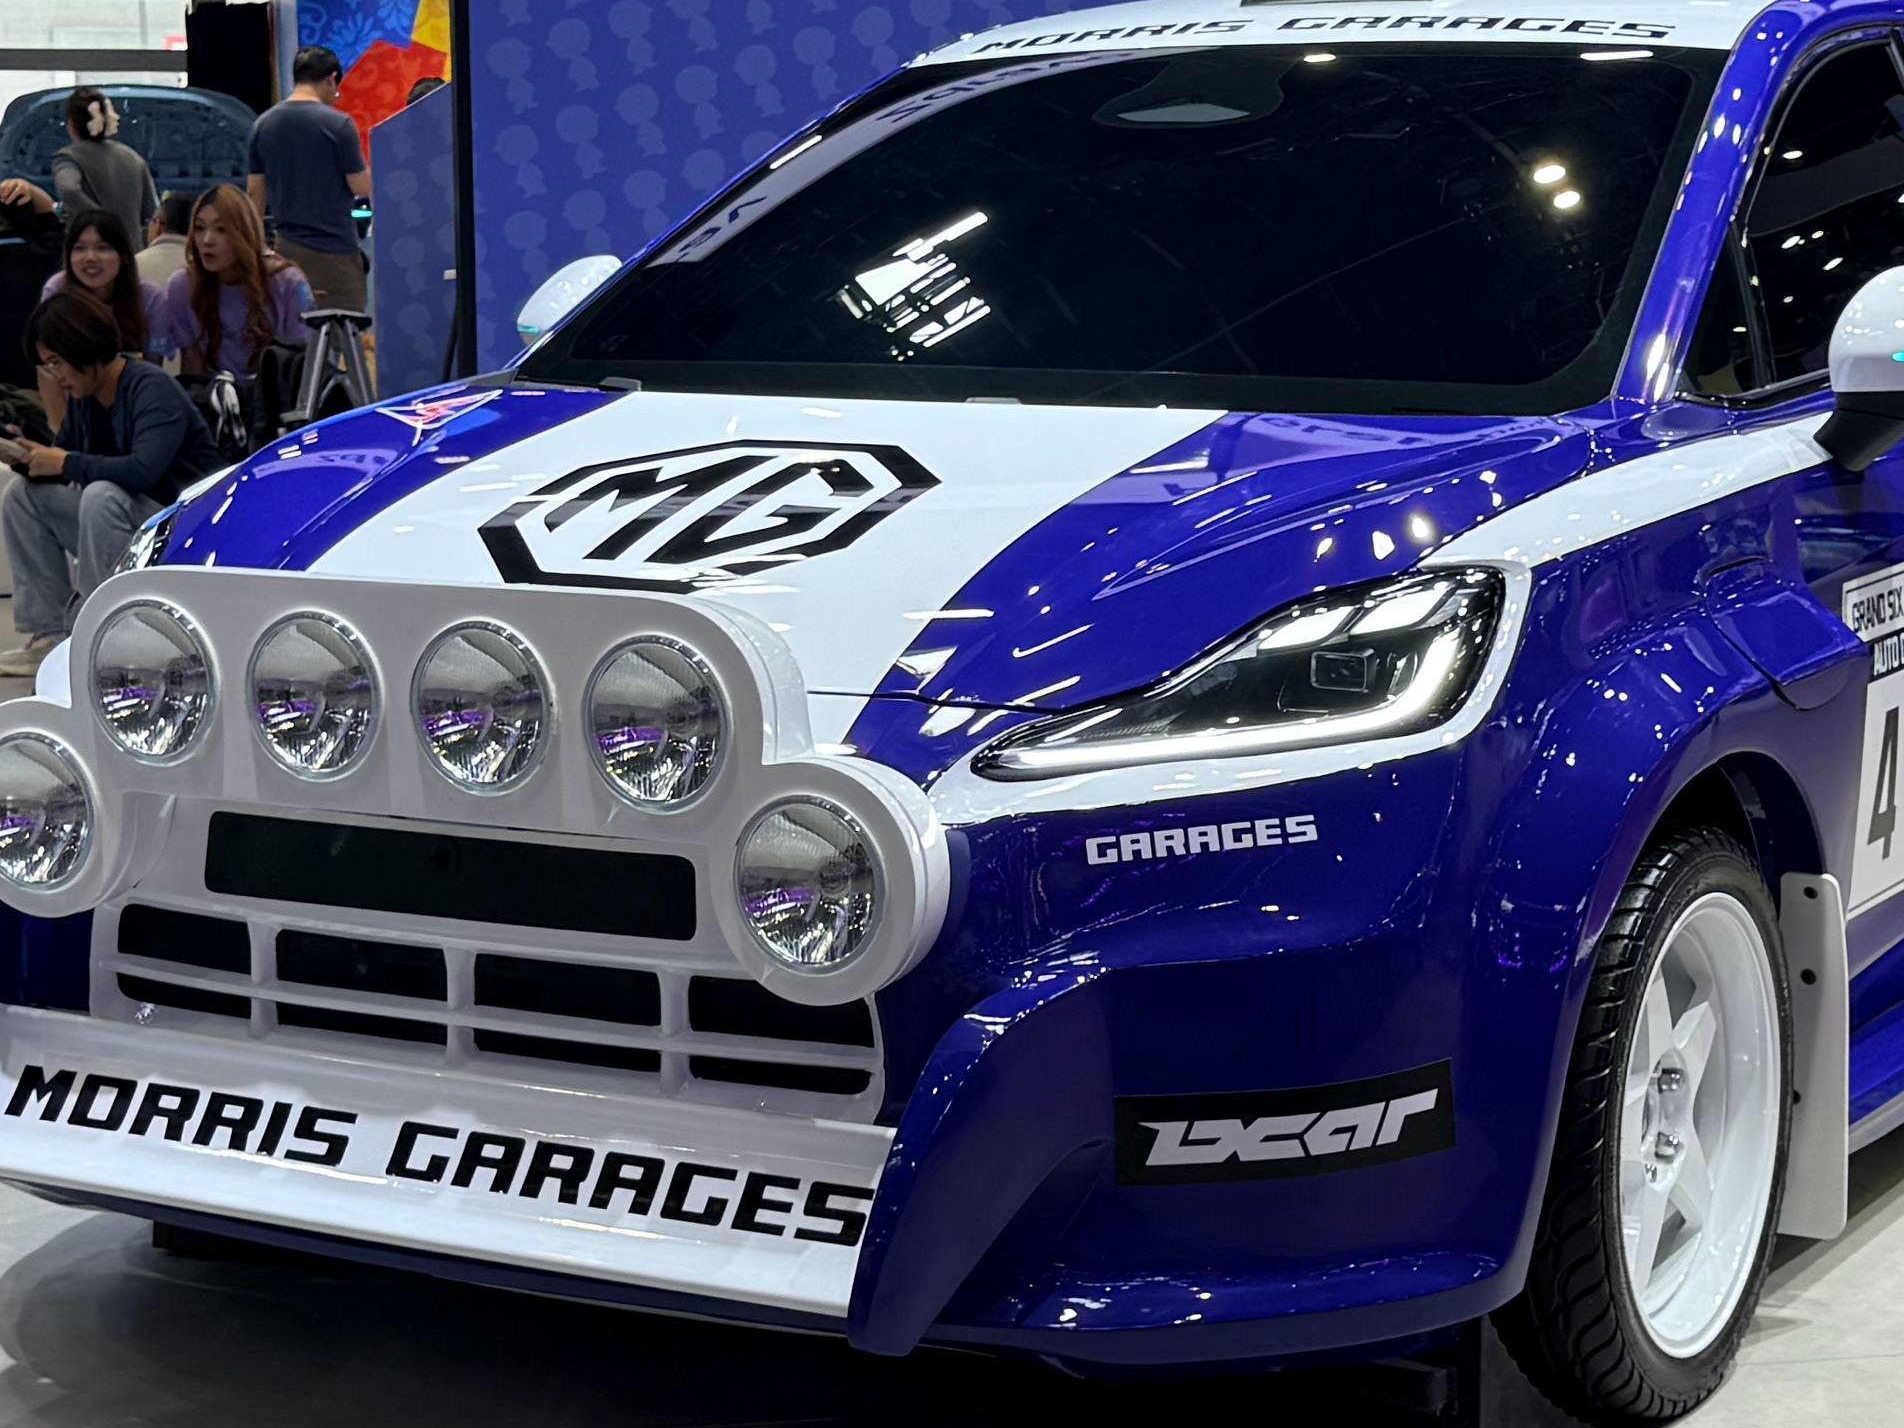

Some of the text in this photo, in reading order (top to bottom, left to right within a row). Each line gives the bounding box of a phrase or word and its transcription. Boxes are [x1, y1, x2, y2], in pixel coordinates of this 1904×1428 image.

[970, 15, 1677, 55] MORRIS GARAGES
[544, 455, 875, 565] MG
[1852, 585, 1904, 633] GRAND SIX
[1873, 635, 1900, 676] AUTO
[1867, 706, 1899, 860] 4
[1085, 815, 1319, 866] GARAGES
[5, 1064, 875, 1247] MORRIS GARAGES
